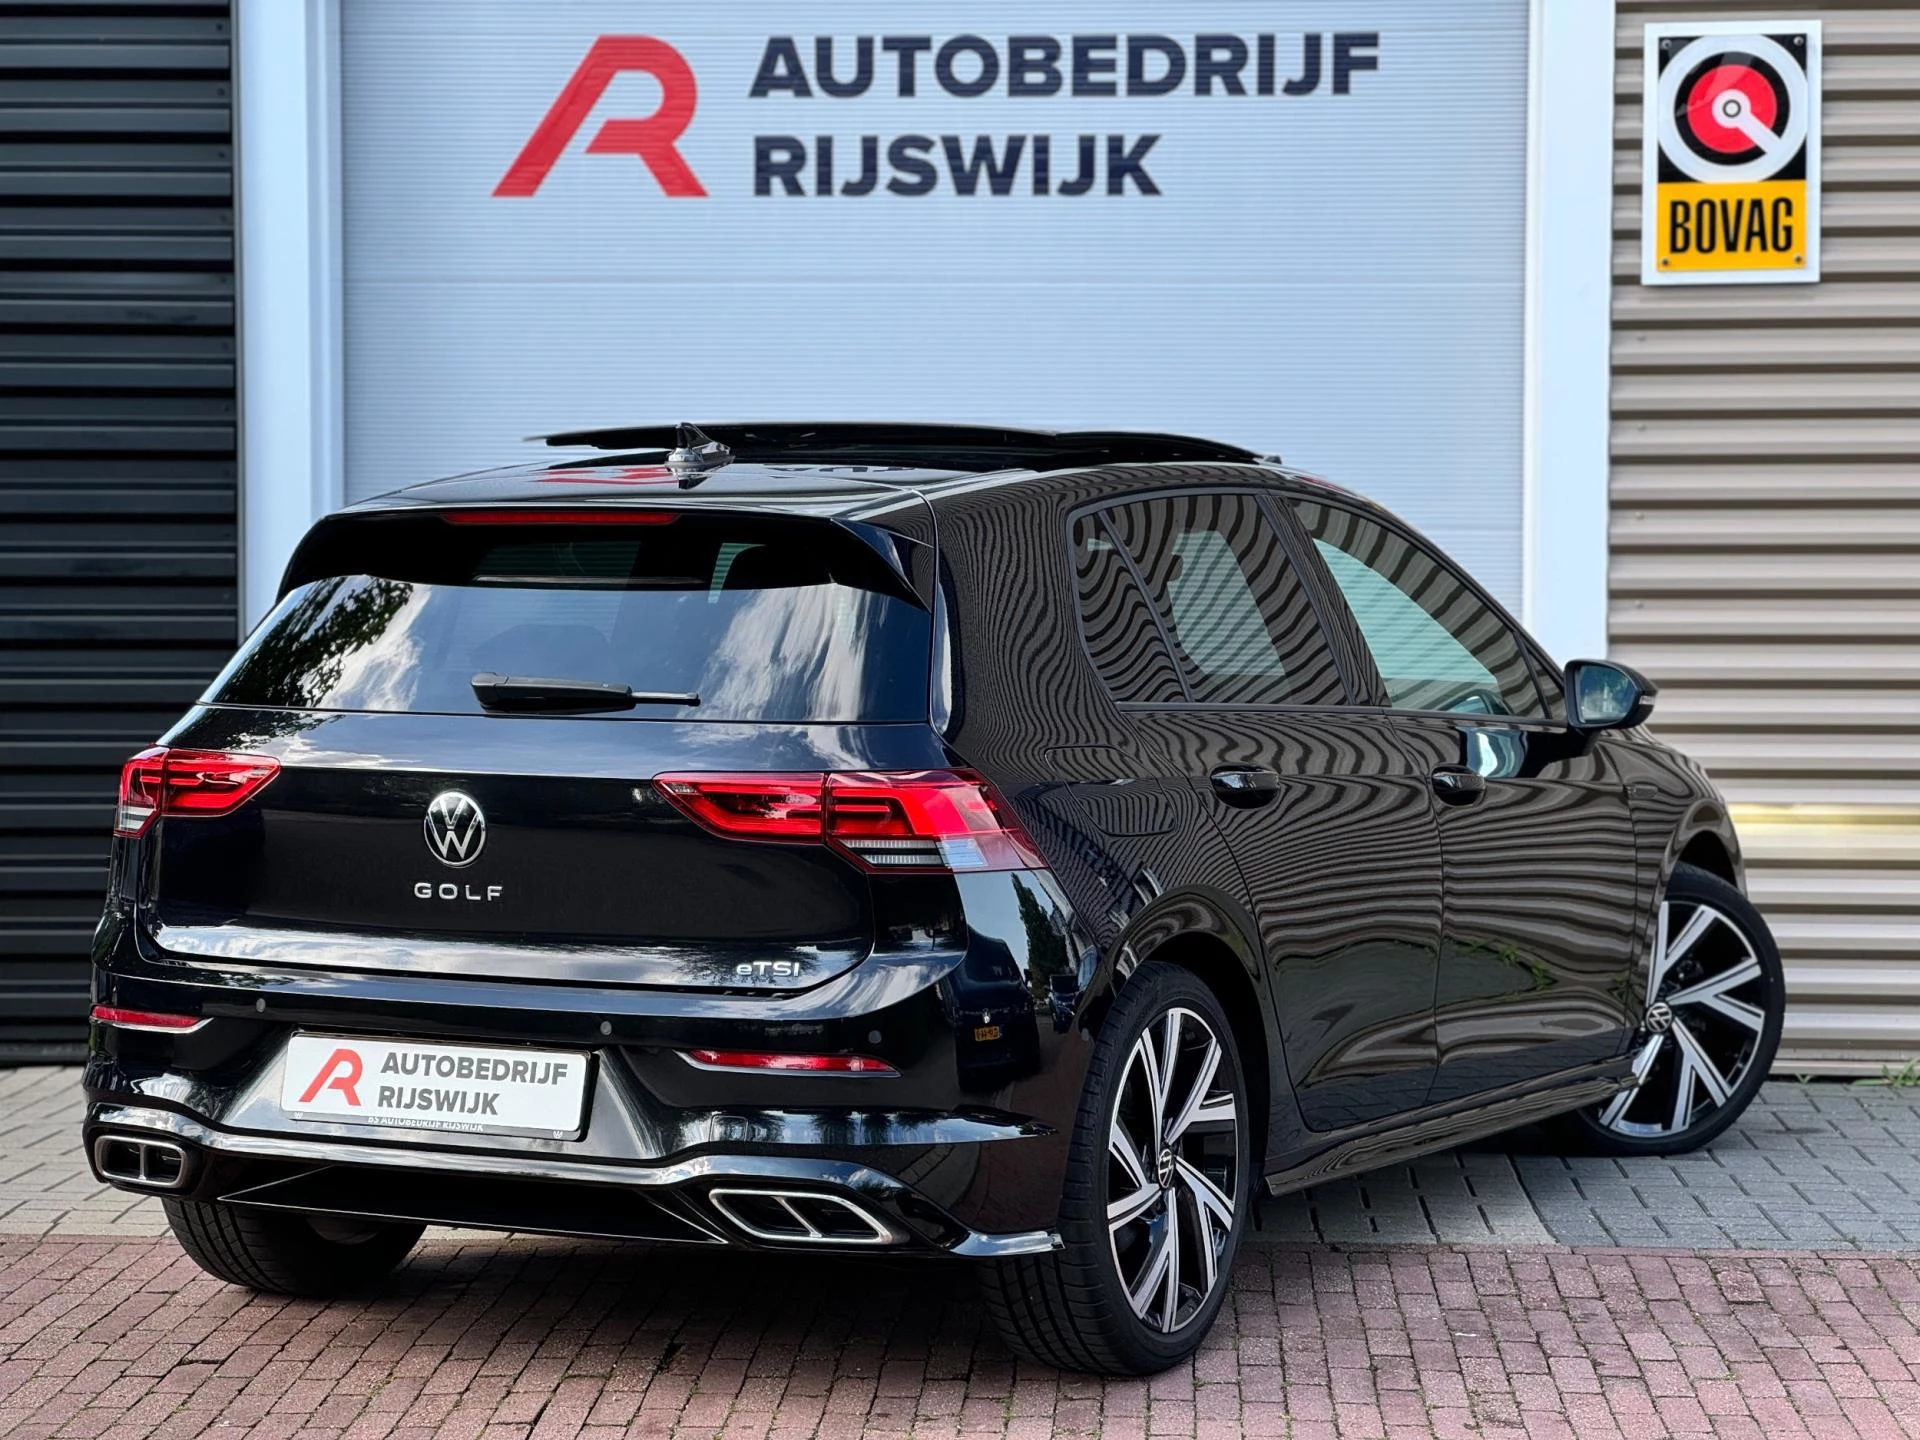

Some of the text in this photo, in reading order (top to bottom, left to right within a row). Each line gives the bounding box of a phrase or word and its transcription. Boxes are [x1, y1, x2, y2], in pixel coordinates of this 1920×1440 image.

[750, 32, 1380, 97] AUTOBEDRIJF
[754, 135, 1162, 197] RIJSWIJK
[1669, 197, 1793, 254] BOVAG
[414, 882, 503, 901] GOLF
[736, 961, 800, 977] eTSI
[380, 1051, 568, 1086] AUTOBEDRIJF
[377, 1086, 500, 1116] RIJSWIJK
